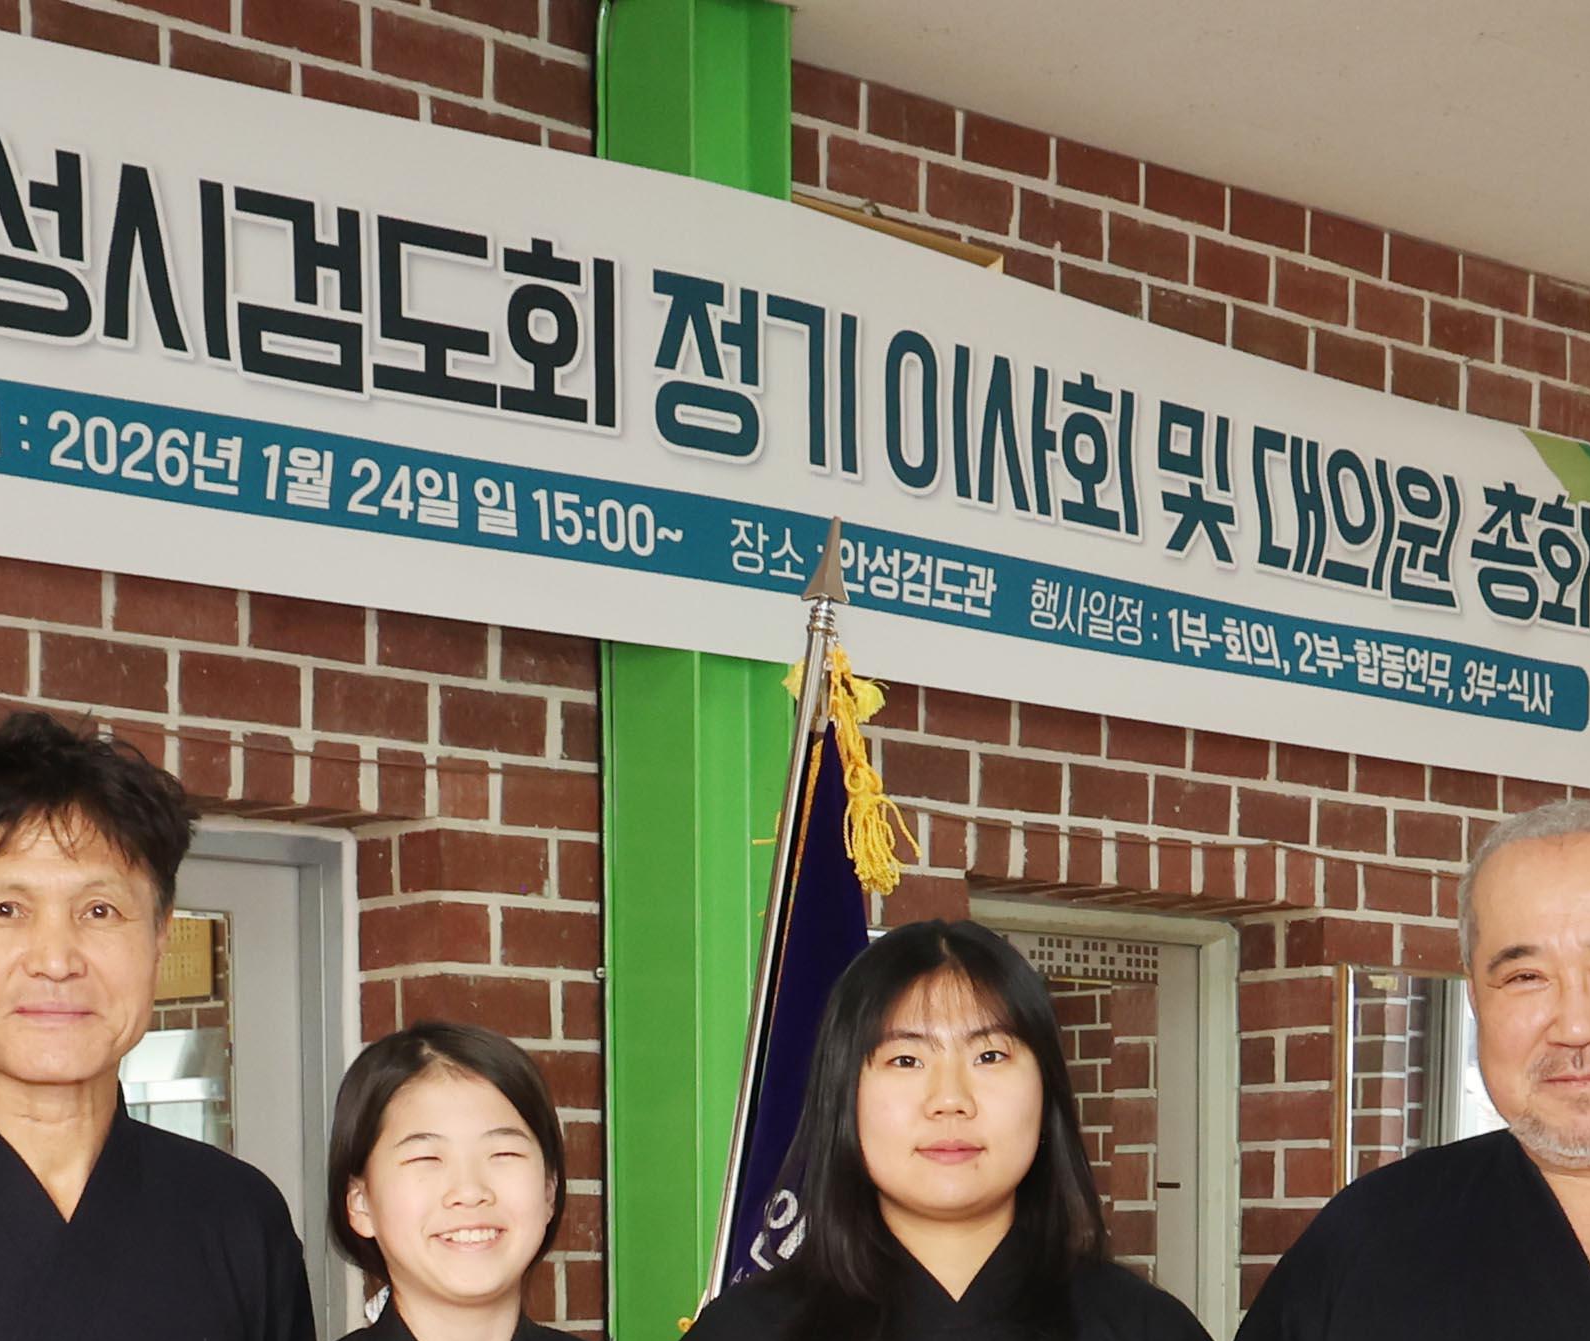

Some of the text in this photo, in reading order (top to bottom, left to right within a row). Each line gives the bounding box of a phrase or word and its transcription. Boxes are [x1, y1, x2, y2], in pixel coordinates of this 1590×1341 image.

[46, 409, 243, 496] 2026년
[262, 443, 334, 511] 1월
[347, 457, 460, 531] 24일
[473, 477, 518, 539] 일
[530, 487, 684, 558] 15:00~
[653, 269, 858, 474] 정기
[885, 330, 1139, 536] 이사회
[1158, 401, 1235, 564] 및
[1253, 425, 1461, 608] 대의원
[728, 516, 806, 582] 장소
[839, 537, 998, 618] 안성검도관
[1028, 577, 1144, 648] 행사일정
[1167, 608, 1292, 676] 1부-회의,
[1460, 659, 1555, 716] 3부-식사
